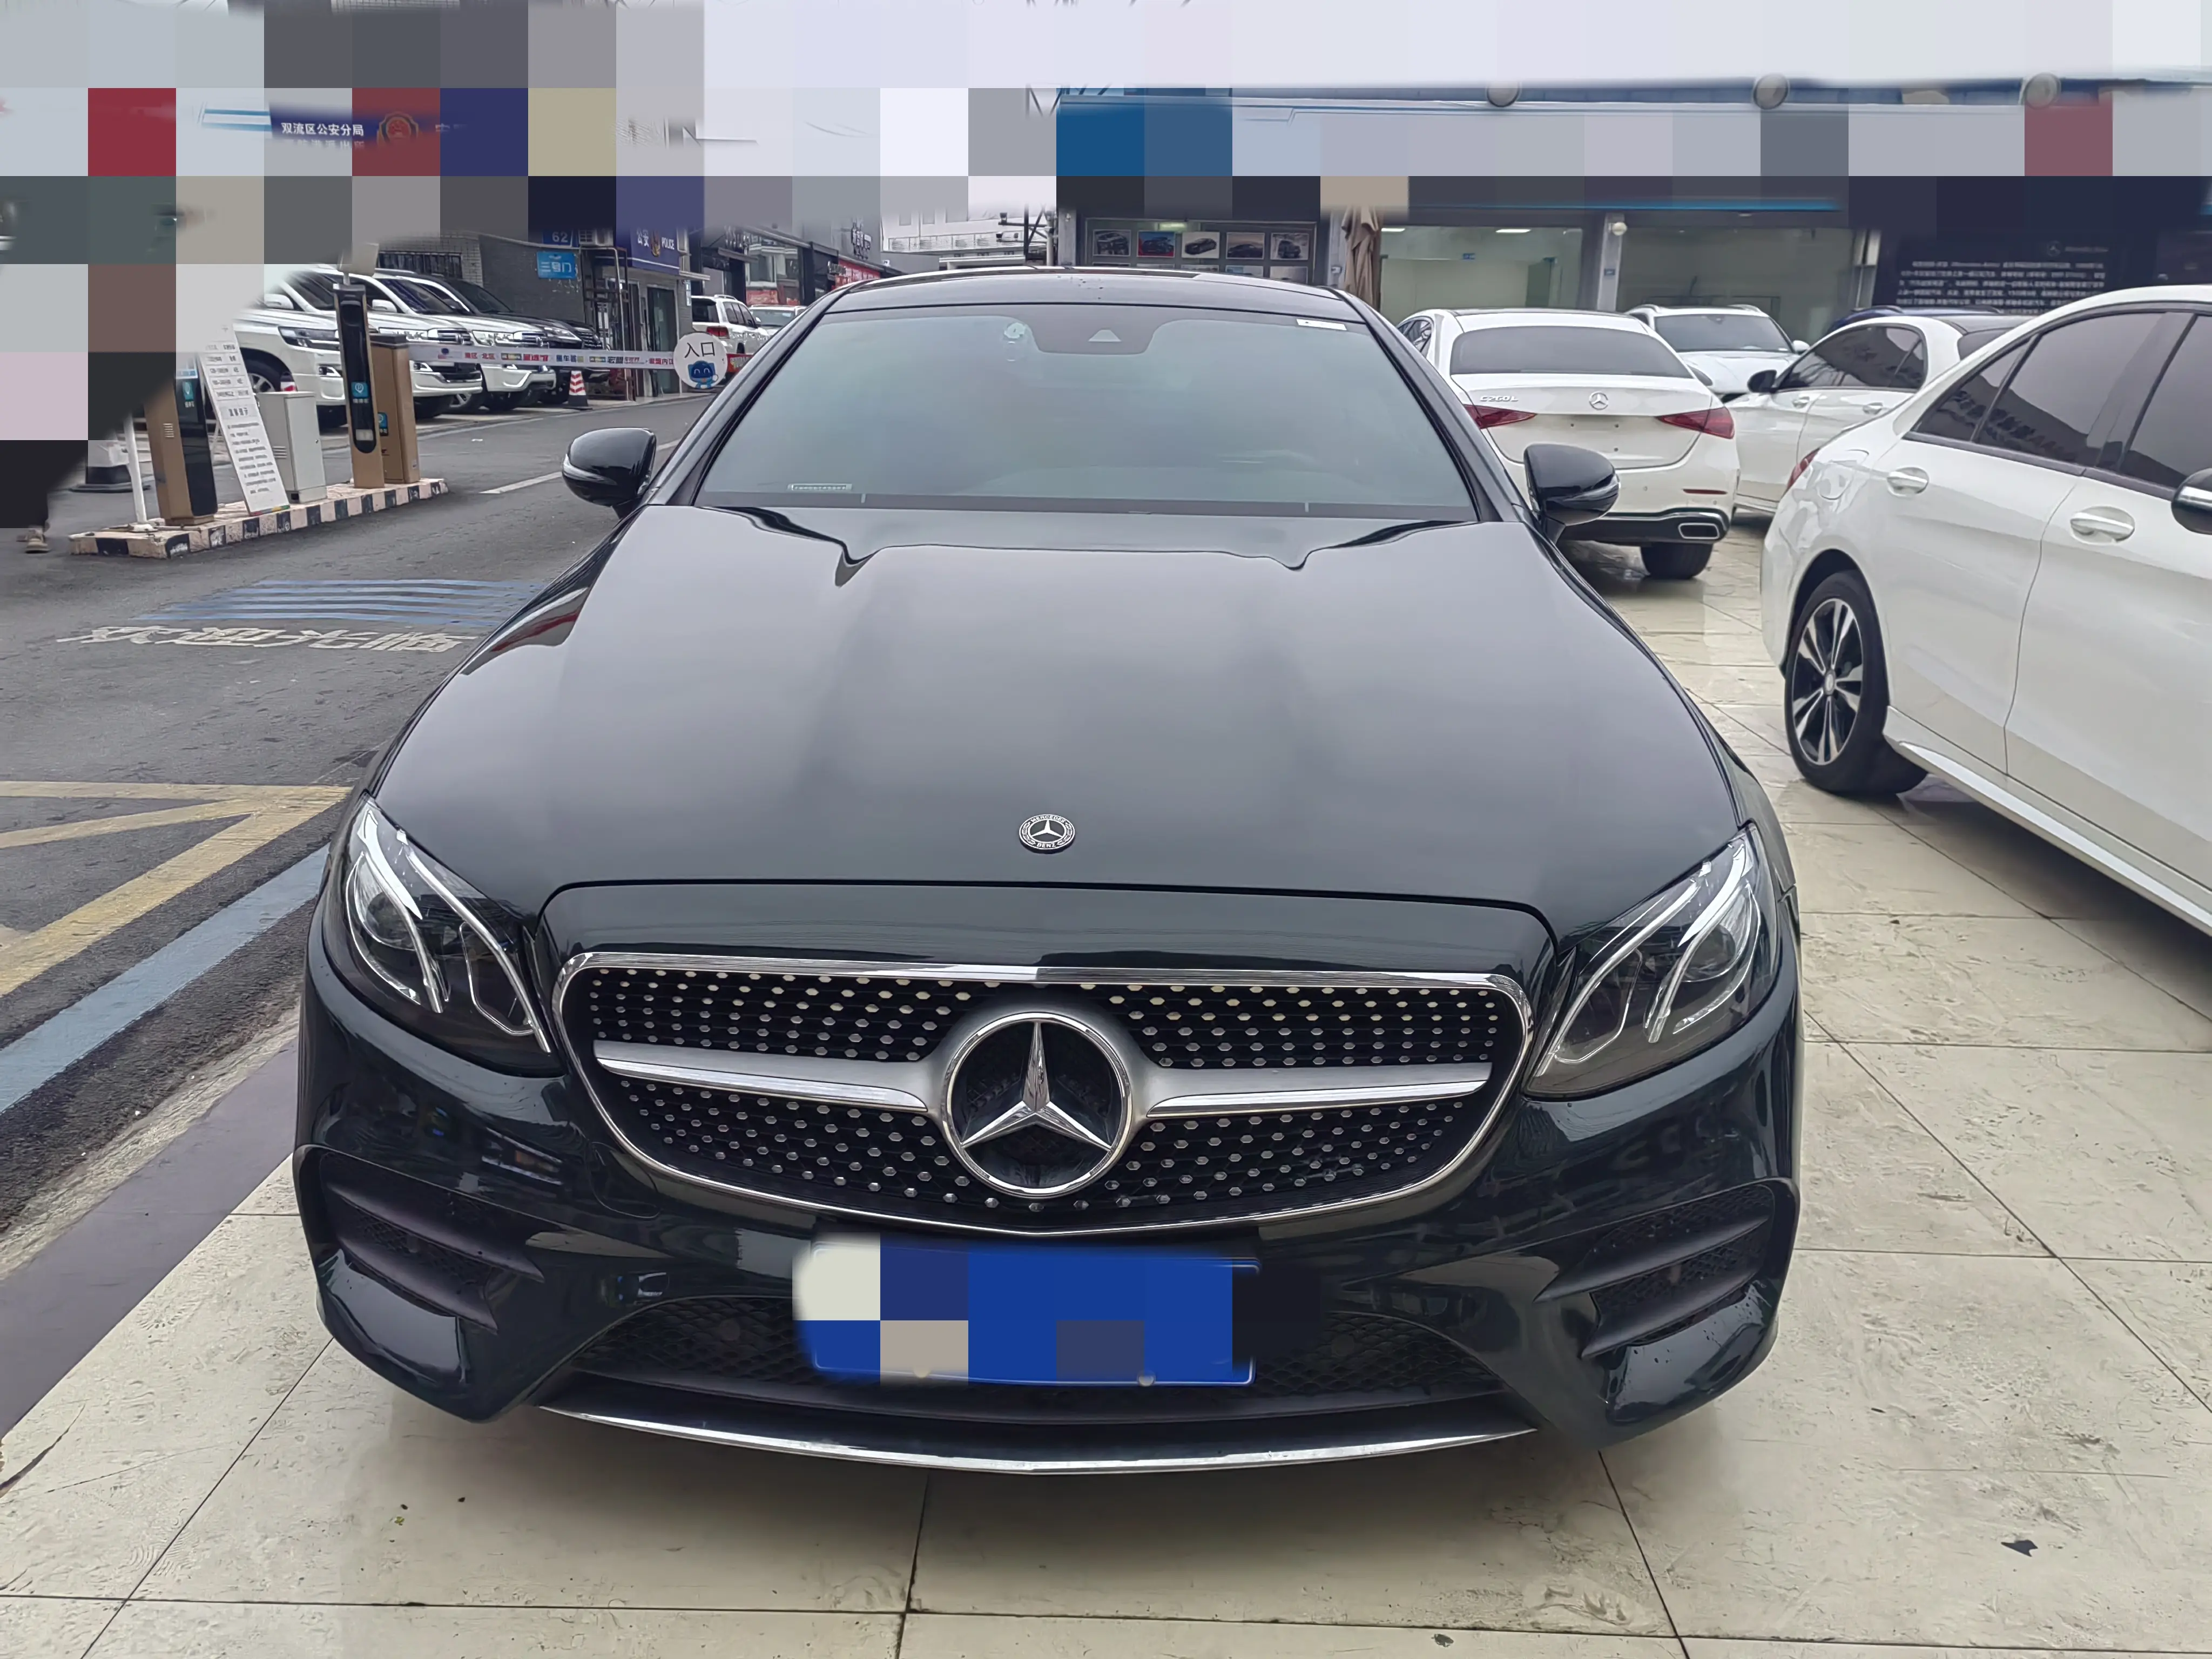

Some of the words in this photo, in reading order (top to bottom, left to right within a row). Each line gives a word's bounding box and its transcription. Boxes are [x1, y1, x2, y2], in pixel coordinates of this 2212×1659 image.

[281, 122, 364, 137] 双流区公安分局
[552, 231, 568, 242] 62
[662, 237, 675, 250] POLICE
[684, 342, 716, 359] 入口
[56, 625, 476, 652] 欢迎光临
[1030, 815, 1066, 823] MERCEDES
